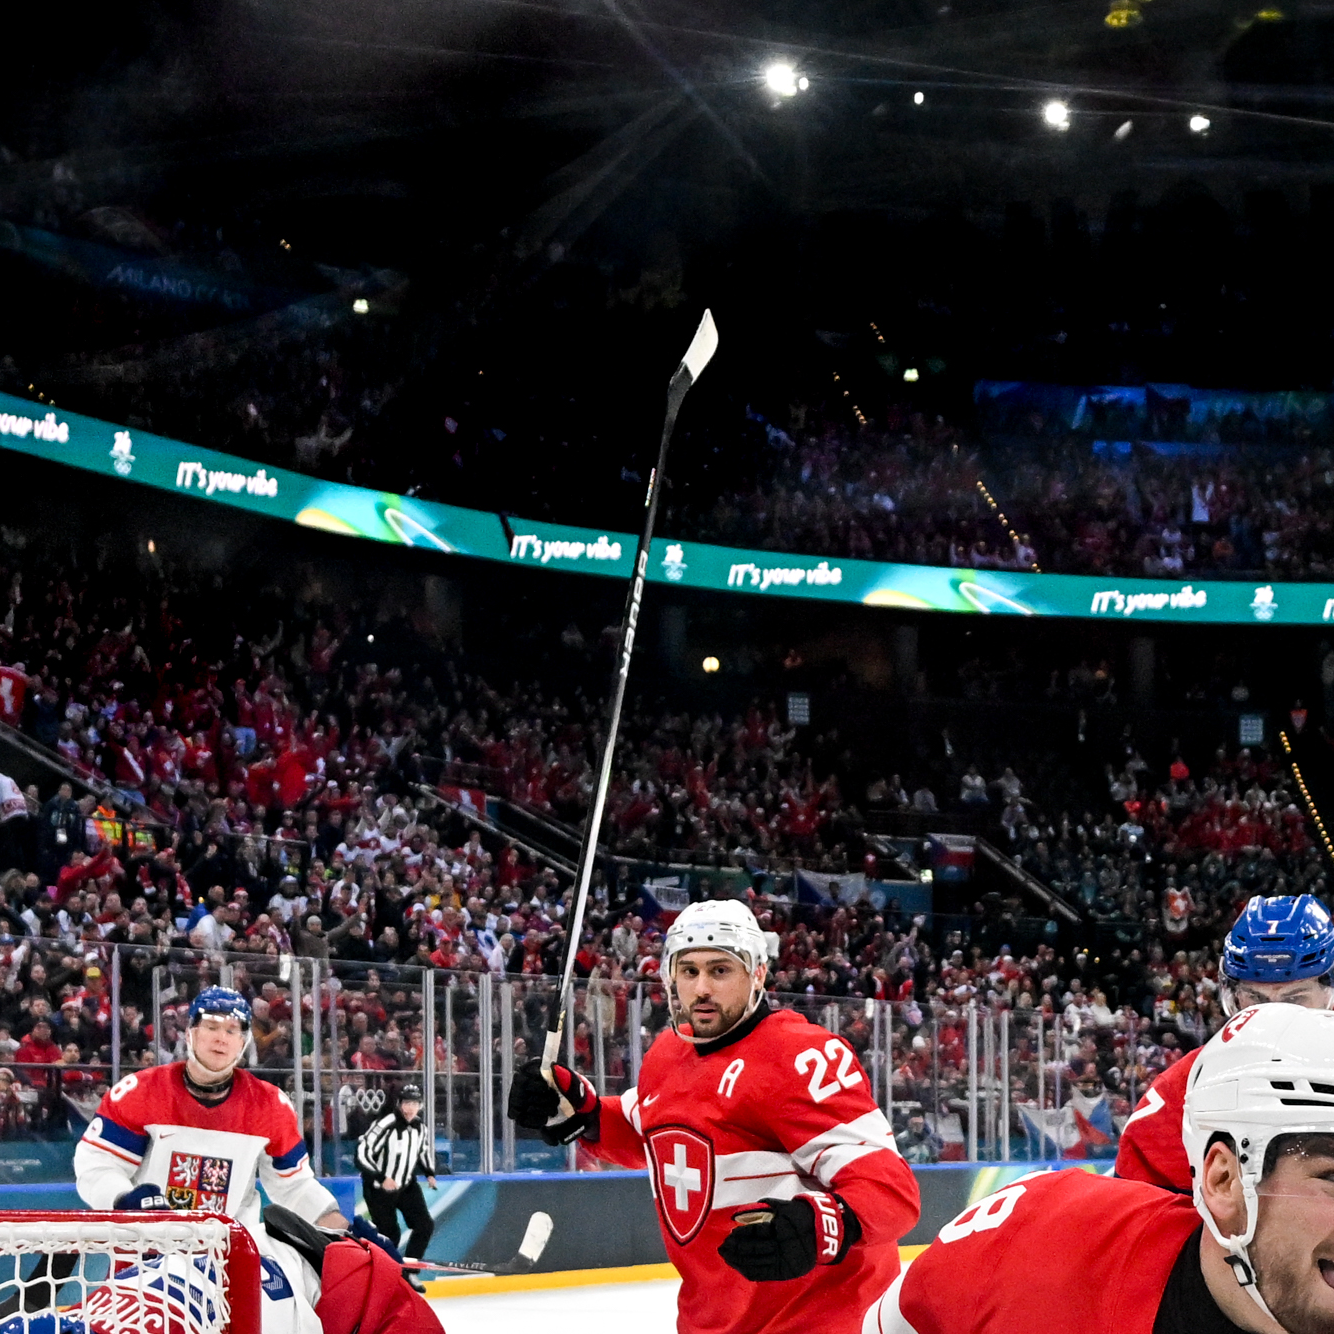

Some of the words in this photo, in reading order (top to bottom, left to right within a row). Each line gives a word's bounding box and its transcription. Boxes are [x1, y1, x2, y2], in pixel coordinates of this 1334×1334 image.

[34, 412, 69, 443] vibe
[206, 470, 246, 495] your
[247, 469, 278, 497] vibe
[541, 540, 585, 564] your
[586, 535, 622, 561] vibe
[759, 568, 806, 591] your
[806, 561, 842, 585] vibe
[1123, 593, 1169, 616] your
[1170, 585, 1207, 609] vibe
[1267, 919, 1279, 935] 7
[717, 1058, 745, 1098] A
[794, 1038, 863, 1104] 22
